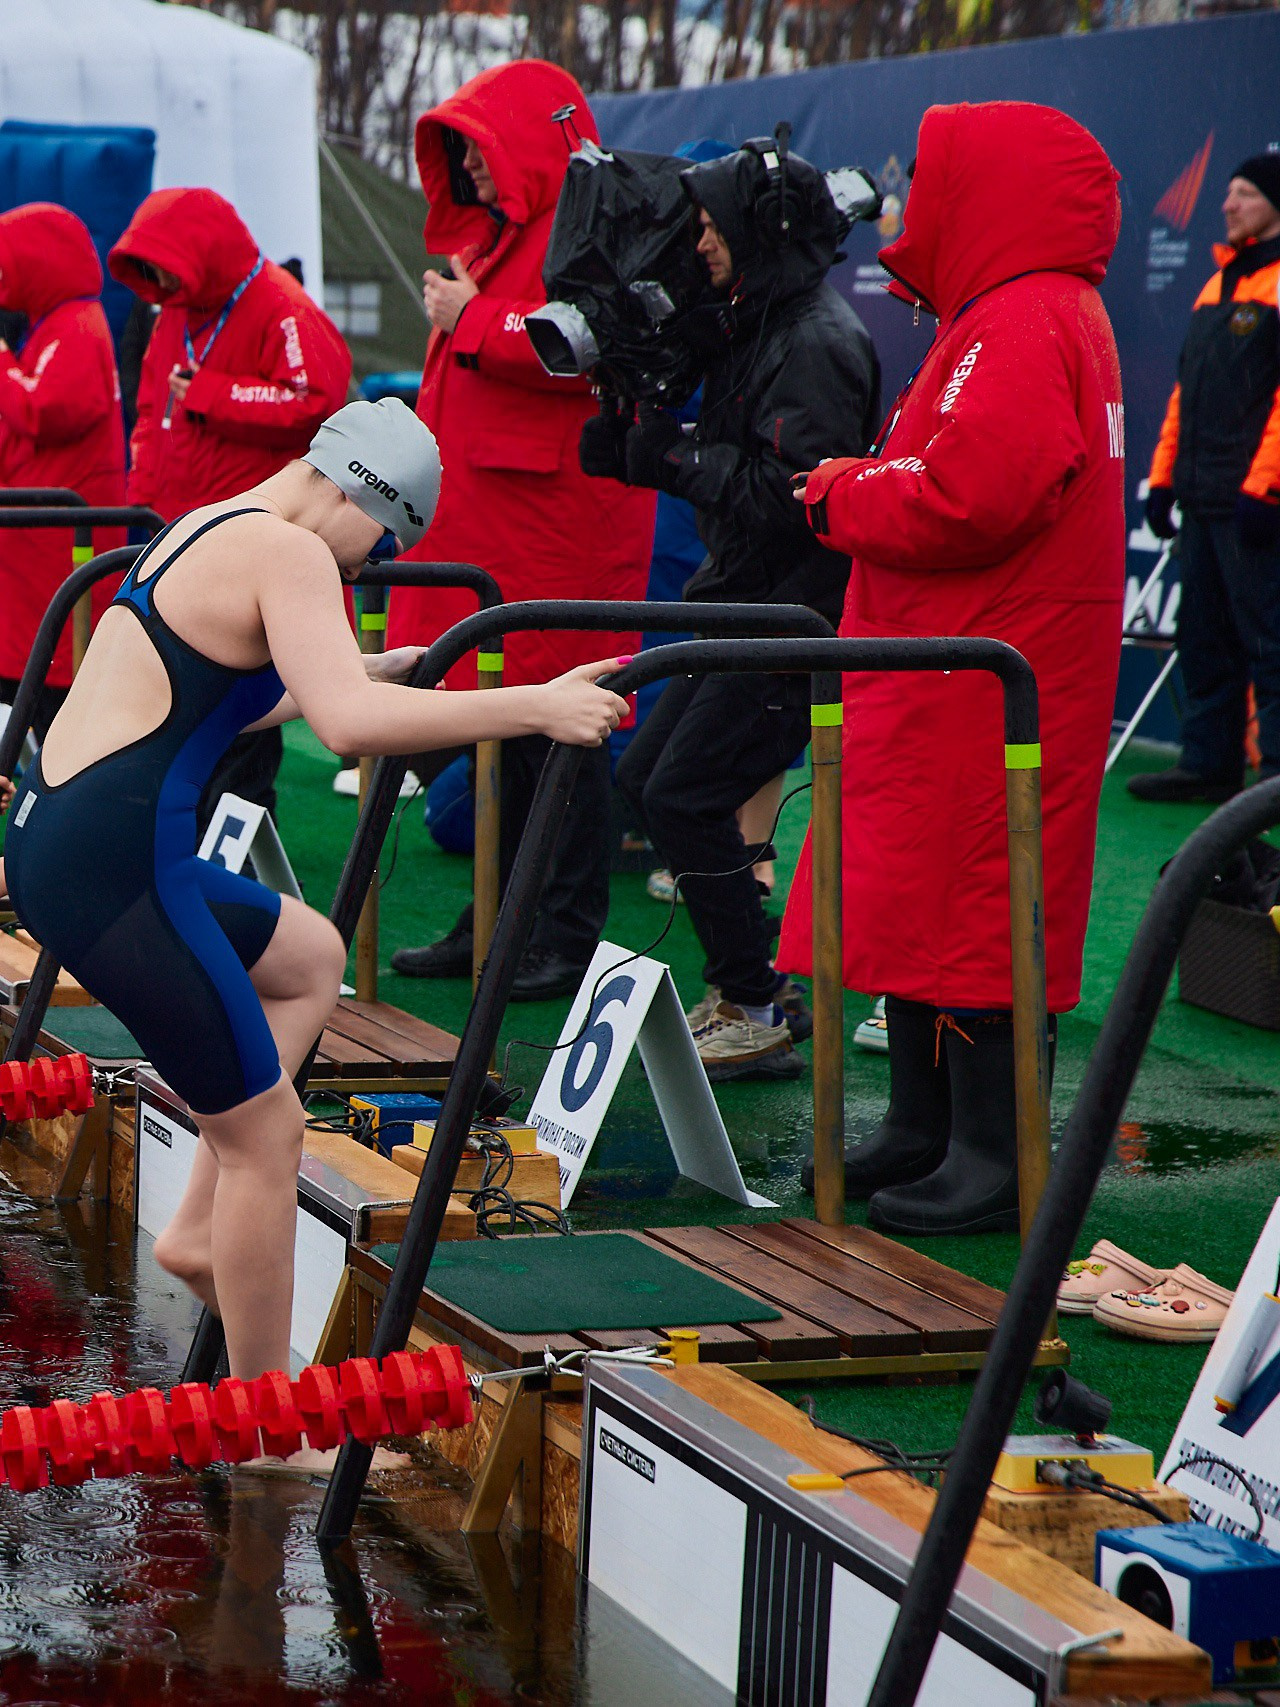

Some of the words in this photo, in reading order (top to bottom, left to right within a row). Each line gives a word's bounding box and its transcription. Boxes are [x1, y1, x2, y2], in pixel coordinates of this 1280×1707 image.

[348, 460, 400, 503] arena
[560, 974, 636, 1113] 6
[560, 1129, 588, 1159] РОССИИ
